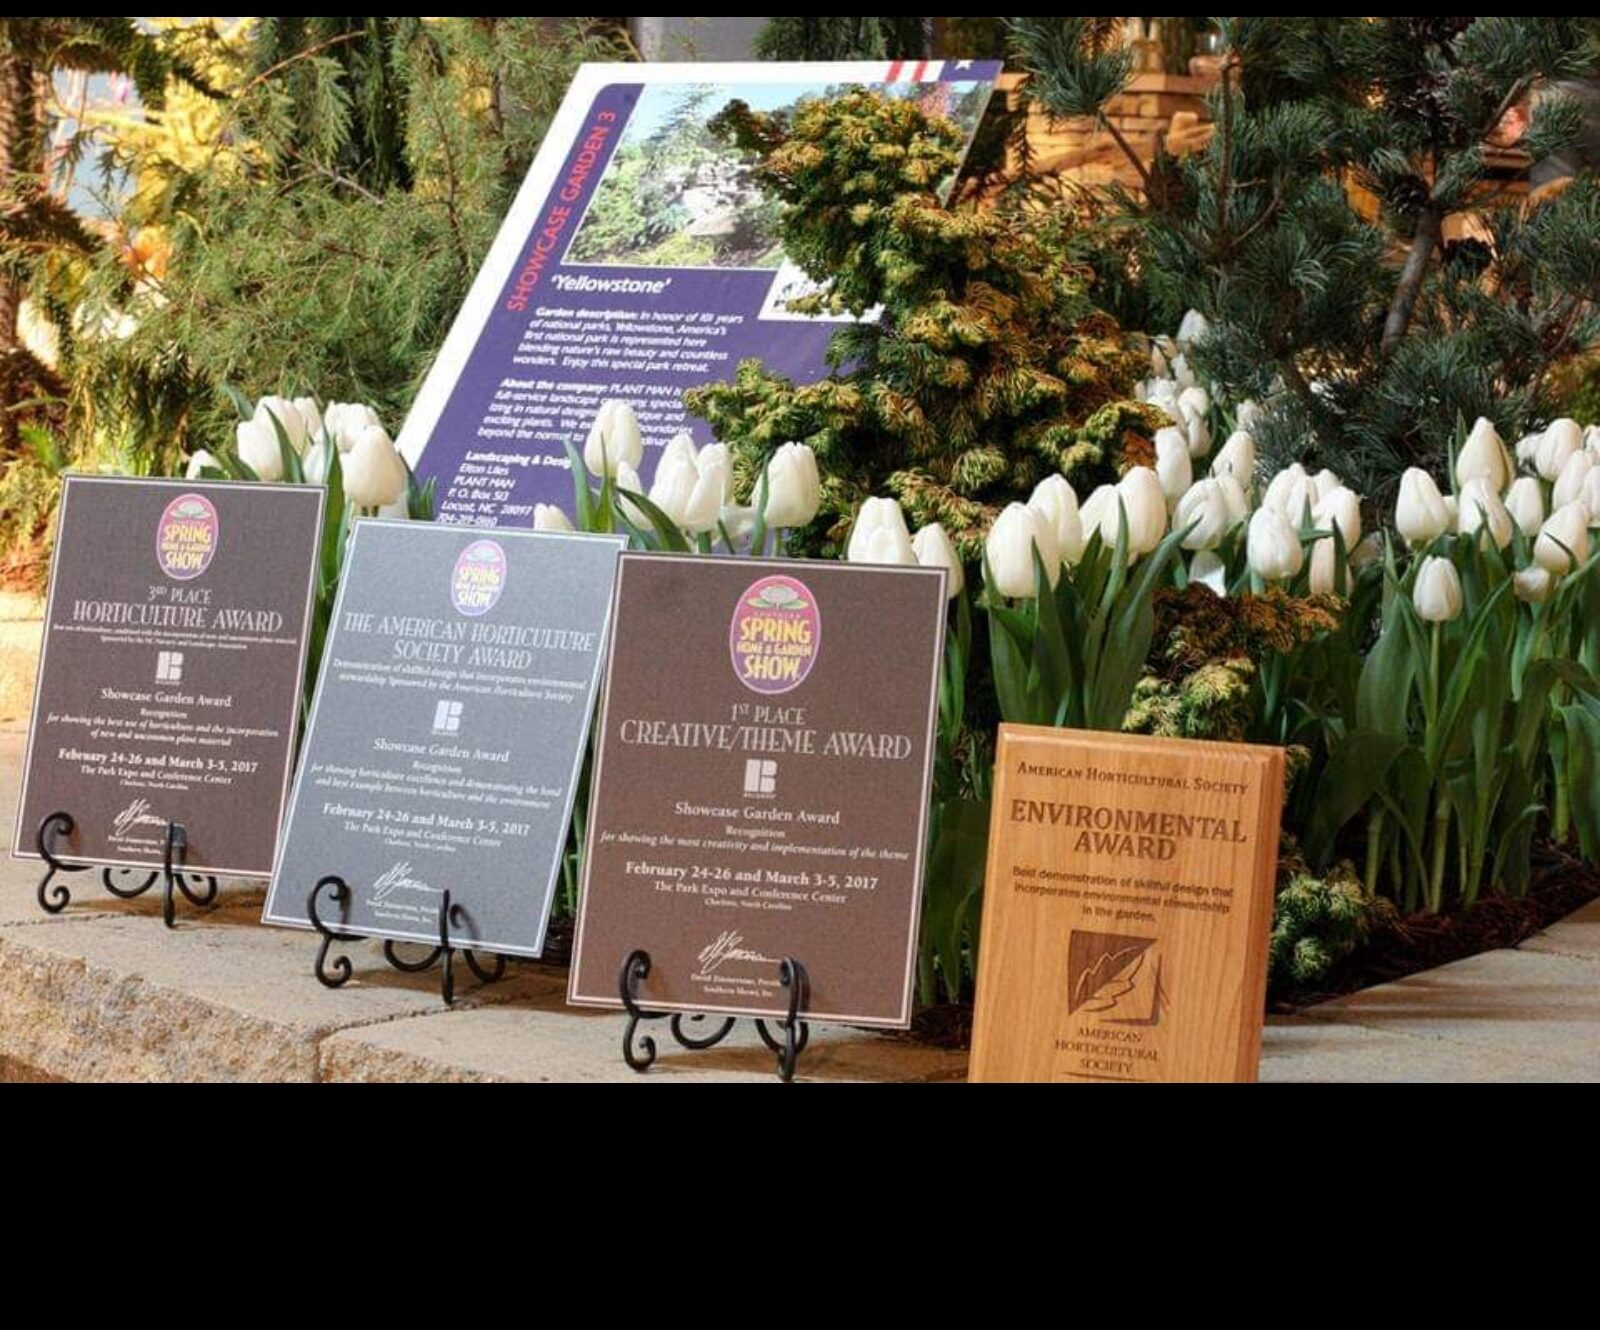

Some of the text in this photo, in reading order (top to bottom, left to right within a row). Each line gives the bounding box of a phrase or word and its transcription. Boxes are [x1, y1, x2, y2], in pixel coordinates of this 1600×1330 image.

[507, 112, 616, 310] SHOWCASE GARDEN 3
[543, 456, 572, 469] Desig
[164, 524, 211, 544] SPRING
[166, 551, 204, 570] SHOW
[171, 588, 212, 604] PLACE
[73, 601, 282, 632] HORTICULTURE AWARD
[343, 613, 596, 652] THE AMERICAN HORTICULTURE
[741, 617, 810, 644] SPRING
[394, 639, 532, 670] SOCIETY AWARD
[744, 655, 800, 680] SHOW
[101, 688, 232, 708] Showcase Garden Award
[754, 707, 806, 725] PLACE
[373, 738, 509, 762] Showcase Garden Award
[620, 720, 911, 759] CREATIVE/THEME AWARD
[58, 748, 108, 764] February
[111, 752, 142, 764] 24-26
[145, 754, 165, 766] and
[169, 756, 202, 769] March
[231, 760, 258, 773] 2017
[1017, 762, 1248, 795] AMERICAN HORTICULTURAL SOCIETY
[322, 802, 374, 821] February
[376, 808, 409, 822] 24-26
[412, 814, 434, 825] and
[438, 815, 473, 830] March
[502, 822, 530, 836] 2017
[675, 802, 839, 824] Showcase Garden Award
[1010, 800, 1248, 843] ENVIRONMENTAL
[1074, 831, 1177, 862] AWARD
[626, 861, 878, 890] February 24-26 and March 3-5, 2017
[1013, 866, 1234, 898] Best demonstration of skillful design that
[654, 880, 846, 904] The Park Expo and Conference Center
[1014, 883, 1230, 914] incorporates environmental stewardship
[1084, 906, 1156, 923] in the garden.
[1077, 1026, 1142, 1044] AMERICAN
[1055, 1038, 1158, 1062] HORTICULTURAL
[1080, 1057, 1134, 1074] SOCIETY
